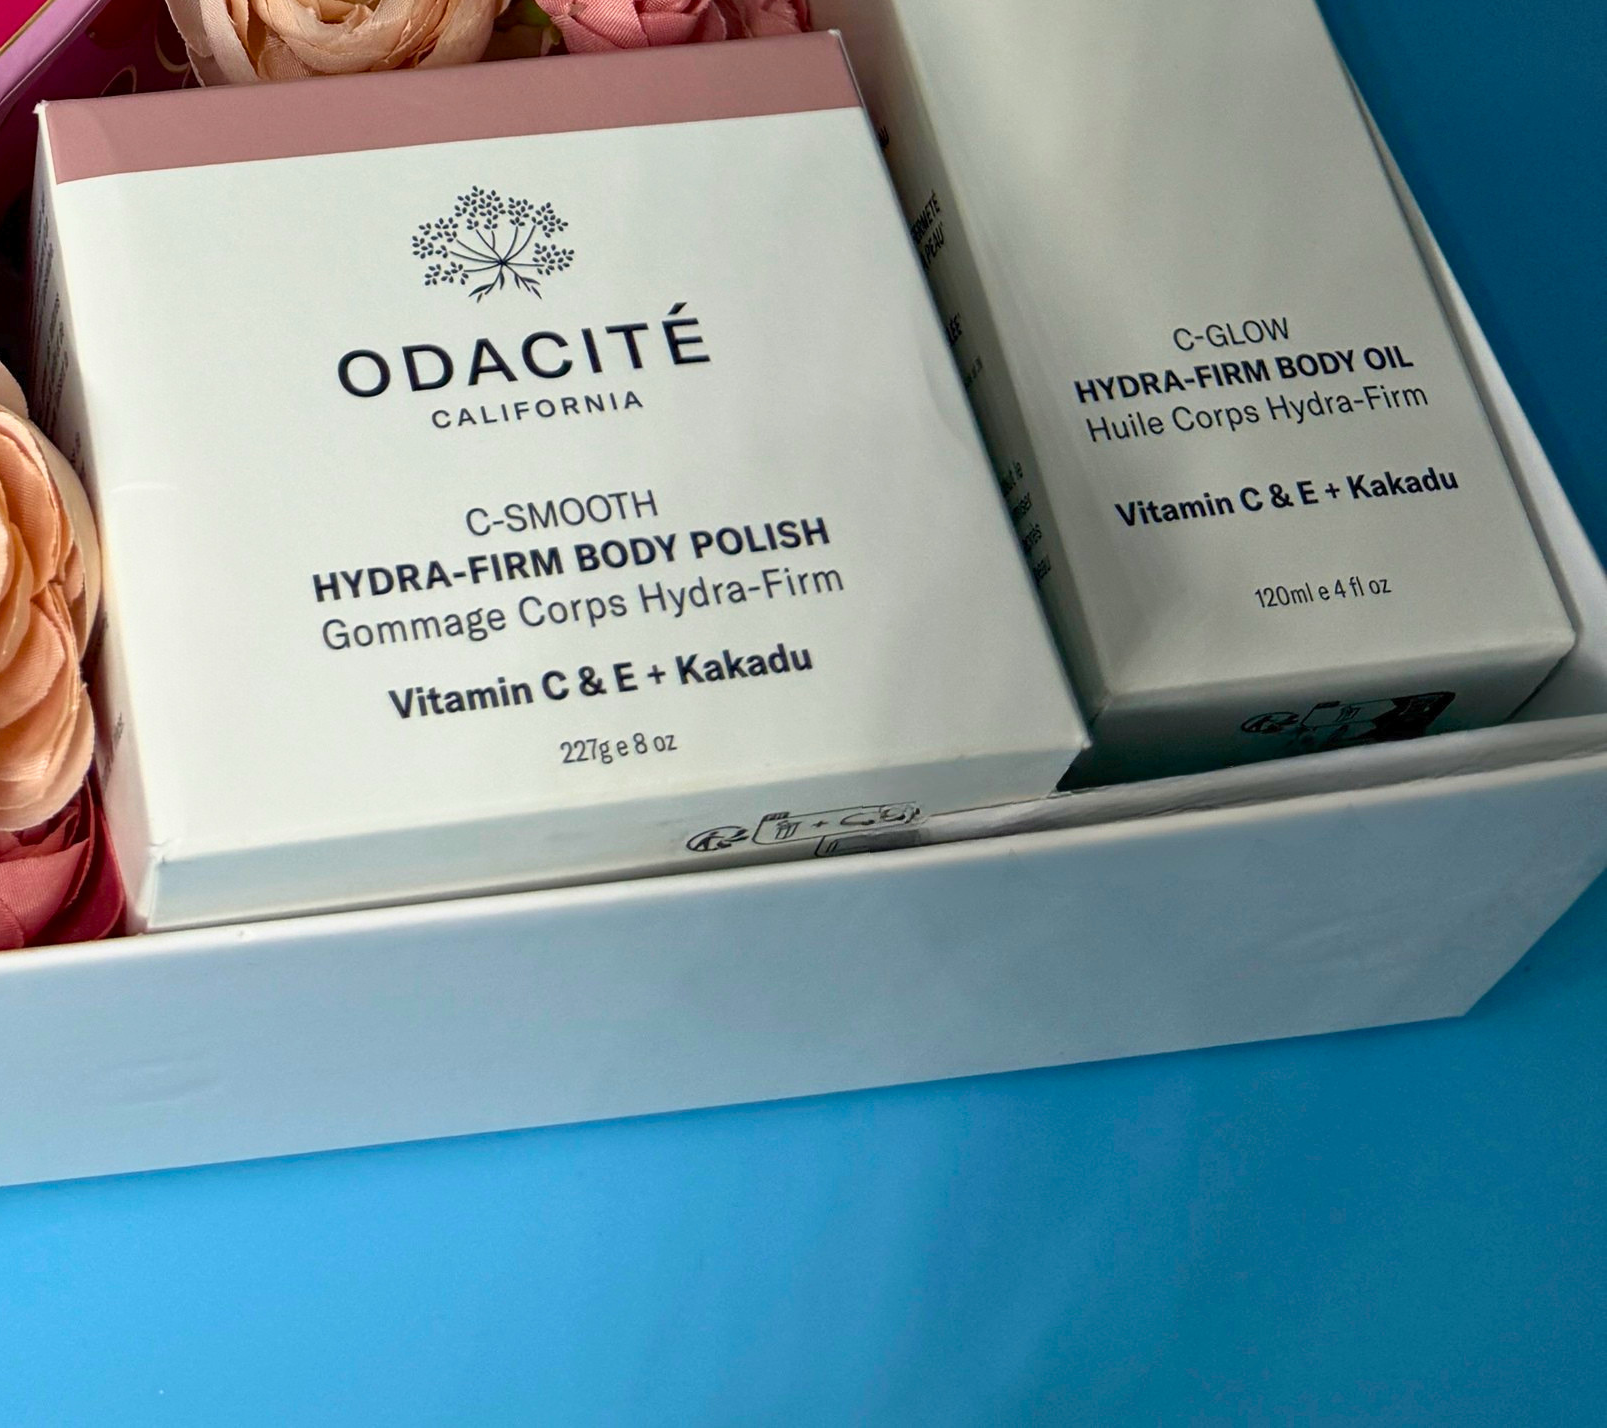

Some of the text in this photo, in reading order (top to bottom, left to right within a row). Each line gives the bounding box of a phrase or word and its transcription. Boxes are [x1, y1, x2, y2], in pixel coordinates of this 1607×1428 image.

[337, 302, 711, 398] ODACITÉ
[1172, 317, 1290, 352] C-GLOW
[1074, 345, 1414, 404] HYDRA-FIRM BODY OIL
[431, 390, 643, 429] CALIFORNIA
[1086, 382, 1429, 442] Huile Corps Hydra-Firm
[465, 489, 658, 536] C-SMOOTH
[1114, 467, 1459, 527] Vitamin C & E + Kakadu
[312, 516, 831, 603] HYDRA-FIRM BODY POLISH
[322, 565, 844, 651] Gommage Corps Hydra-Firm
[1255, 581, 1314, 609] 120ml
[1334, 579, 1346, 599] 4
[1348, 577, 1365, 596] fl
[1370, 577, 1392, 595] oz
[388, 643, 813, 720] Vitamin C & E + Kakadu
[560, 739, 613, 765] 227g
[633, 733, 648, 755] 8
[652, 732, 678, 753] oz
